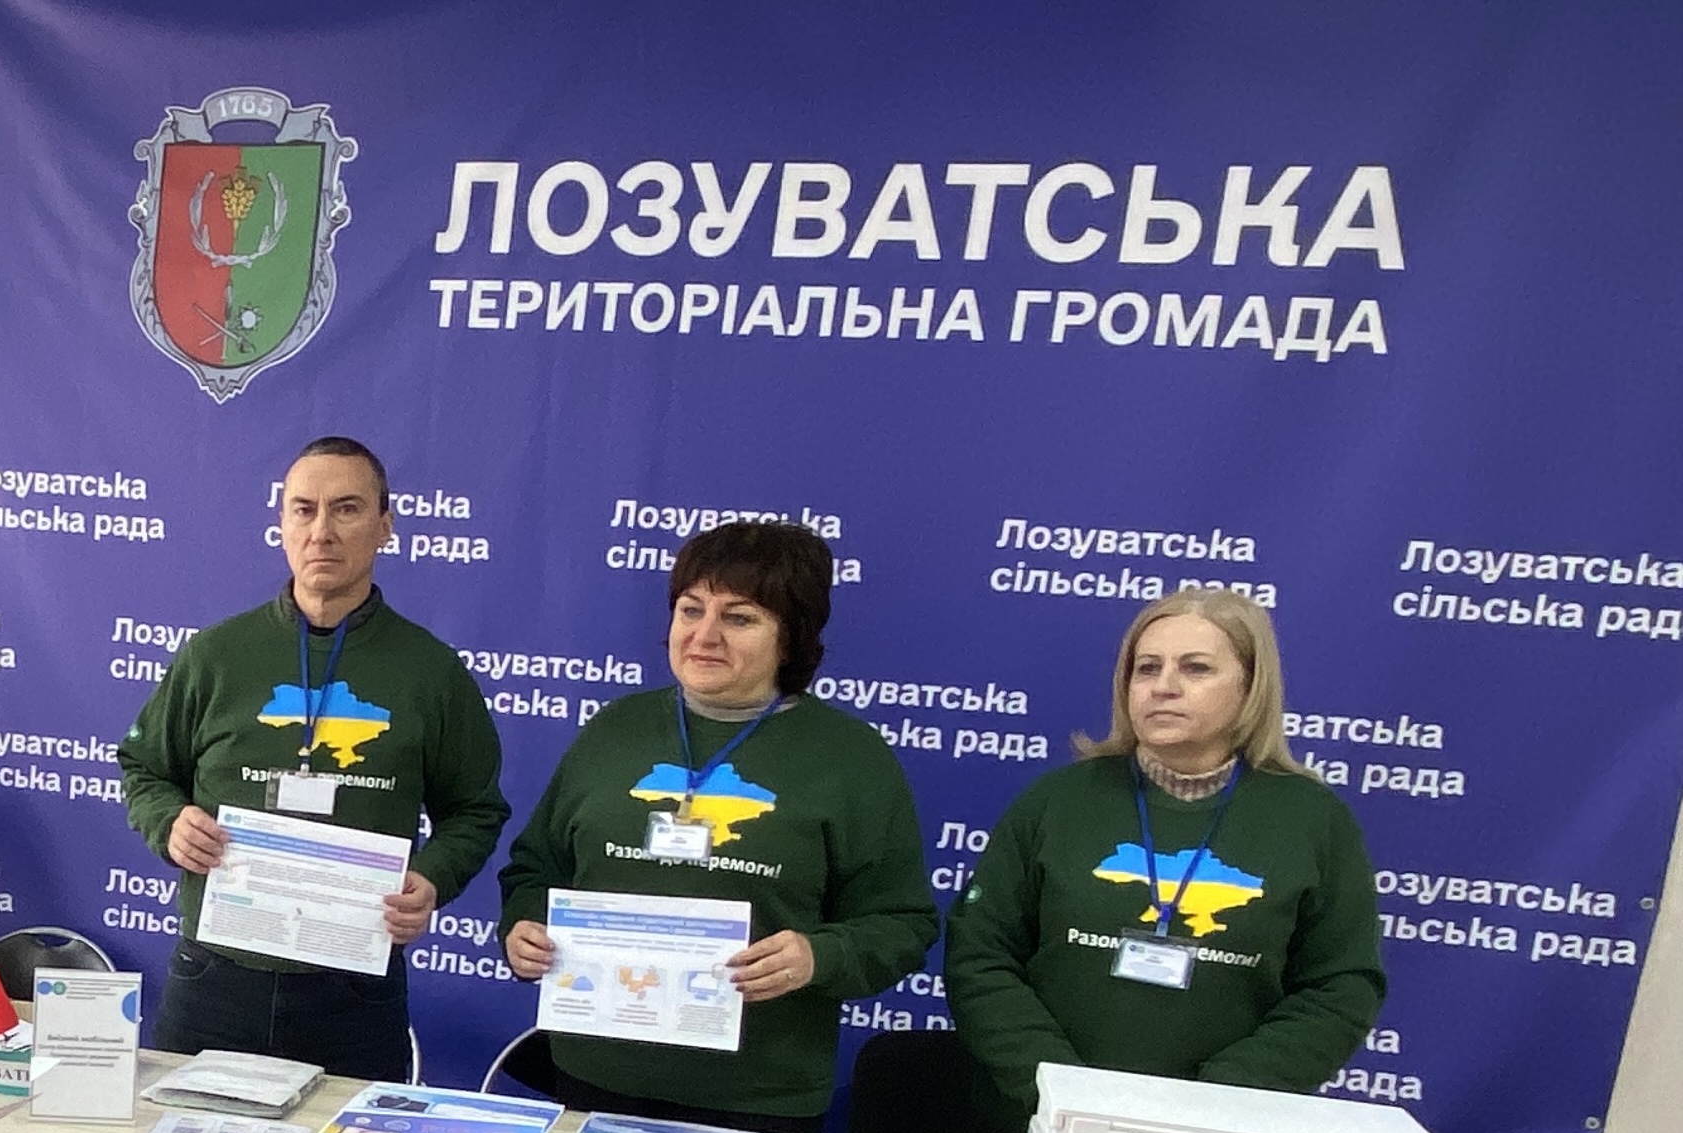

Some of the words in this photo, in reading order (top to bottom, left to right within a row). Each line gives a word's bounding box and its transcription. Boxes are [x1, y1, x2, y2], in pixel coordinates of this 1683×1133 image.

[218, 95, 274, 118] 1765
[435, 159, 1406, 272] ЛОЗУВАТСЬКА
[430, 279, 984, 342] ТЕРИТОРІАЛЬНА
[1009, 289, 1389, 362] ГРОМАДА
[94, 512, 165, 542] рада
[996, 518, 1256, 562] Лозуватська
[410, 534, 489, 563] рада
[606, 540, 677, 572] сіль
[1399, 540, 1683, 588] Лозуватська
[990, 561, 1164, 600] сільська
[1393, 584, 1583, 628] сільська
[1596, 605, 1682, 640] рад
[457, 649, 643, 685] озуватська
[484, 688, 568, 719] ська
[808, 676, 1028, 715] озуватська
[953, 728, 1048, 762] рада
[1283, 712, 1443, 749] ватська
[69, 774, 126, 803] рад
[1361, 763, 1465, 798] рада
[1374, 870, 1617, 918] озуватська
[102, 903, 183, 936] сільс
[1378, 913, 1518, 952] льська
[1531, 930, 1638, 967] рада
[411, 944, 516, 981] сільсь
